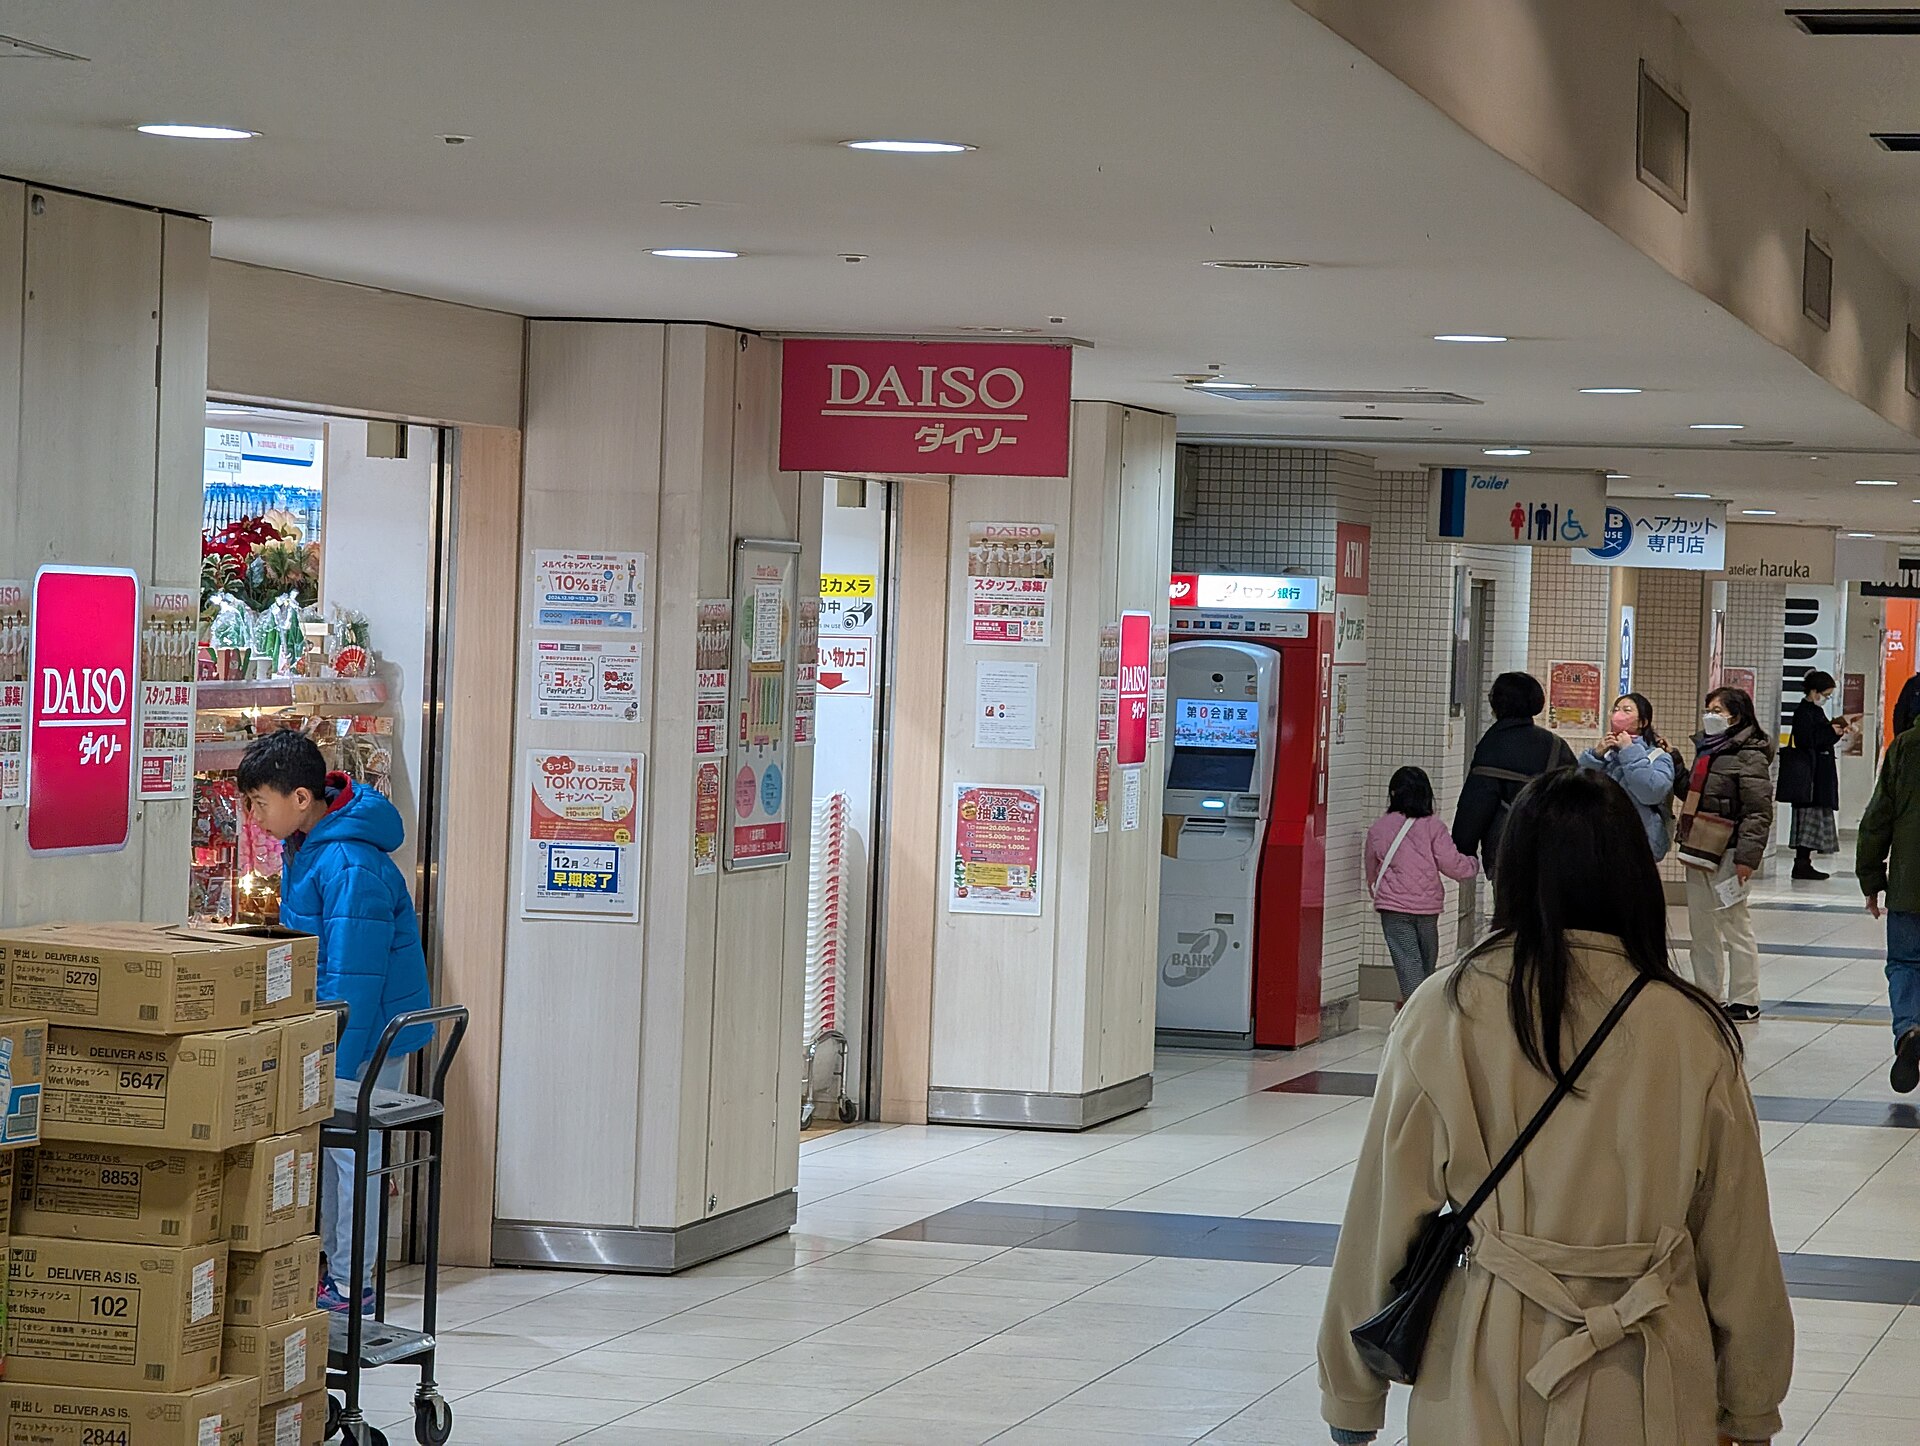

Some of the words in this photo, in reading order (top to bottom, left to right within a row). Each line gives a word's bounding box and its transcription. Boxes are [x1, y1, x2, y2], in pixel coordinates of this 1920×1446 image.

[826, 364, 1025, 409] DAISO
[914, 423, 1017, 454] ダイソー
[1470, 475, 1510, 491] Toilet
[1609, 513, 1624, 529] B
[1636, 516, 1718, 535] ヘアカット
[986, 526, 1041, 538] DAISO
[1604, 531, 1623, 539] USE
[1647, 535, 1705, 554] 専門店
[1344, 541, 1363, 578] ATM
[1728, 564, 1757, 577] atelier
[1759, 559, 1811, 578] haruka
[555, 574, 590, 591] 10%
[154, 593, 189, 610] DAISO
[554, 671, 572, 688] 3%
[1121, 666, 1147, 692] DAISO
[41, 667, 127, 714] DAISO
[546, 687, 587, 695] PayPayクーポン
[79, 730, 123, 766] ダイソー
[546, 762, 573, 771] もっと!
[543, 775, 626, 792] TOKYO元気
[555, 791, 614, 804] キャンペーン
[978, 794, 1018, 806] クリスマス
[553, 857, 579, 869] 12月
[582, 857, 603, 869] 24
[605, 861, 614, 870] 日
[552, 871, 613, 889] 早期終了
[45, 953, 78, 963] DELIVER
[79, 955, 91, 964] AS
[1171, 952, 1214, 967] BANK
[66, 970, 98, 986] 5279
[199, 985, 215, 996] 5279
[90, 1047, 136, 1061] DELIVER
[138, 1051, 153, 1062] AS
[155, 1052, 168, 1063] IS.
[49, 1063, 110, 1077] ウェットティッシュ
[48, 1076, 64, 1085] Wet
[66, 1077, 90, 1087] Wipes
[119, 1071, 165, 1091] 5647
[43, 1105, 62, 1114] E-1
[68, 1153, 100, 1162] DELIVER
[101, 1155, 112, 1163] AS
[100, 1169, 139, 1187] 8853
[8, 1263, 35, 1278] 出し
[47, 1267, 101, 1283] DELIVER
[103, 1271, 122, 1284] AS
[124, 1272, 141, 1285] IS.
[8, 1288, 71, 1301] ェットティッシュ
[8, 1304, 19, 1314] et
[19, 1303, 46, 1315] tissue
[90, 1295, 128, 1318] 102
[10, 1400, 43, 1413] 甲出し
[53, 1403, 98, 1417] DELIVER
[100, 1407, 116, 1418] AS
[118, 1408, 130, 1418] IS.
[14, 1421, 74, 1434] ウェットティッシュ
[82, 1427, 127, 1446] 2844
